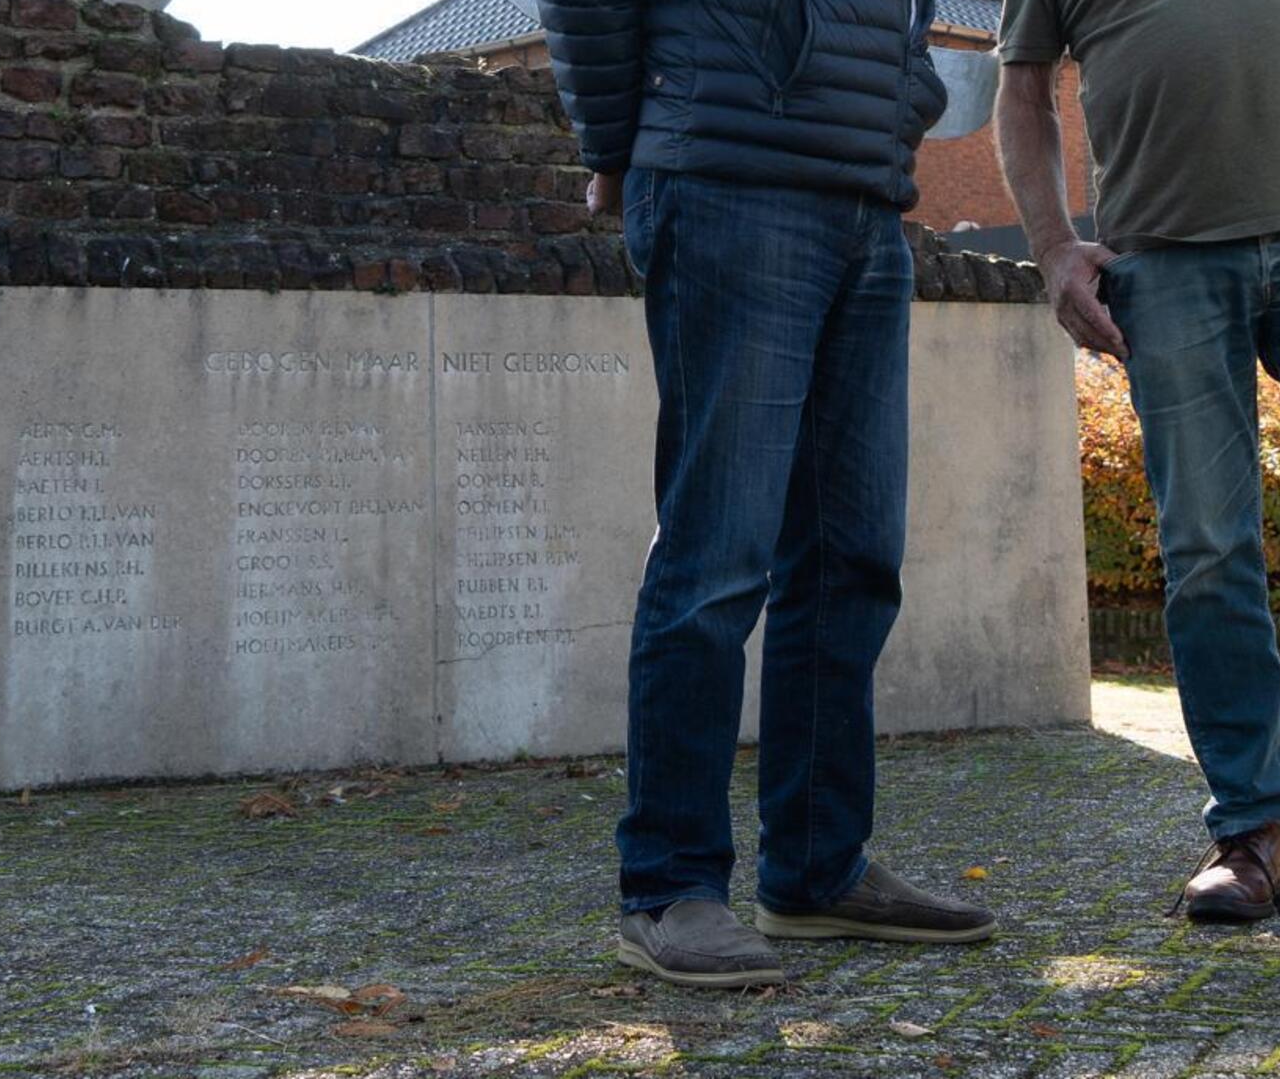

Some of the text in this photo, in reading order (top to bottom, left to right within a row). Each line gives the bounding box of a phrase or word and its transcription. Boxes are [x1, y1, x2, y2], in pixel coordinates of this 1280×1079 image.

[204, 351, 630, 374] GEBOGEN MAAR NIET GEBROKEN
[20, 422, 74, 439] AERTS
[20, 450, 75, 467] AERTS
[457, 447, 518, 463] NELLEN
[17, 477, 87, 496] BAETEN
[457, 473, 524, 489] OOMEN
[17, 505, 71, 523] BERLO
[457, 499, 524, 516] OOMEN
[16, 532, 71, 550] BERLO
[237, 527, 326, 545] FRANSSEN
[16, 560, 109, 579] BILLEKENS
[458, 577, 519, 595] PUBBEN
